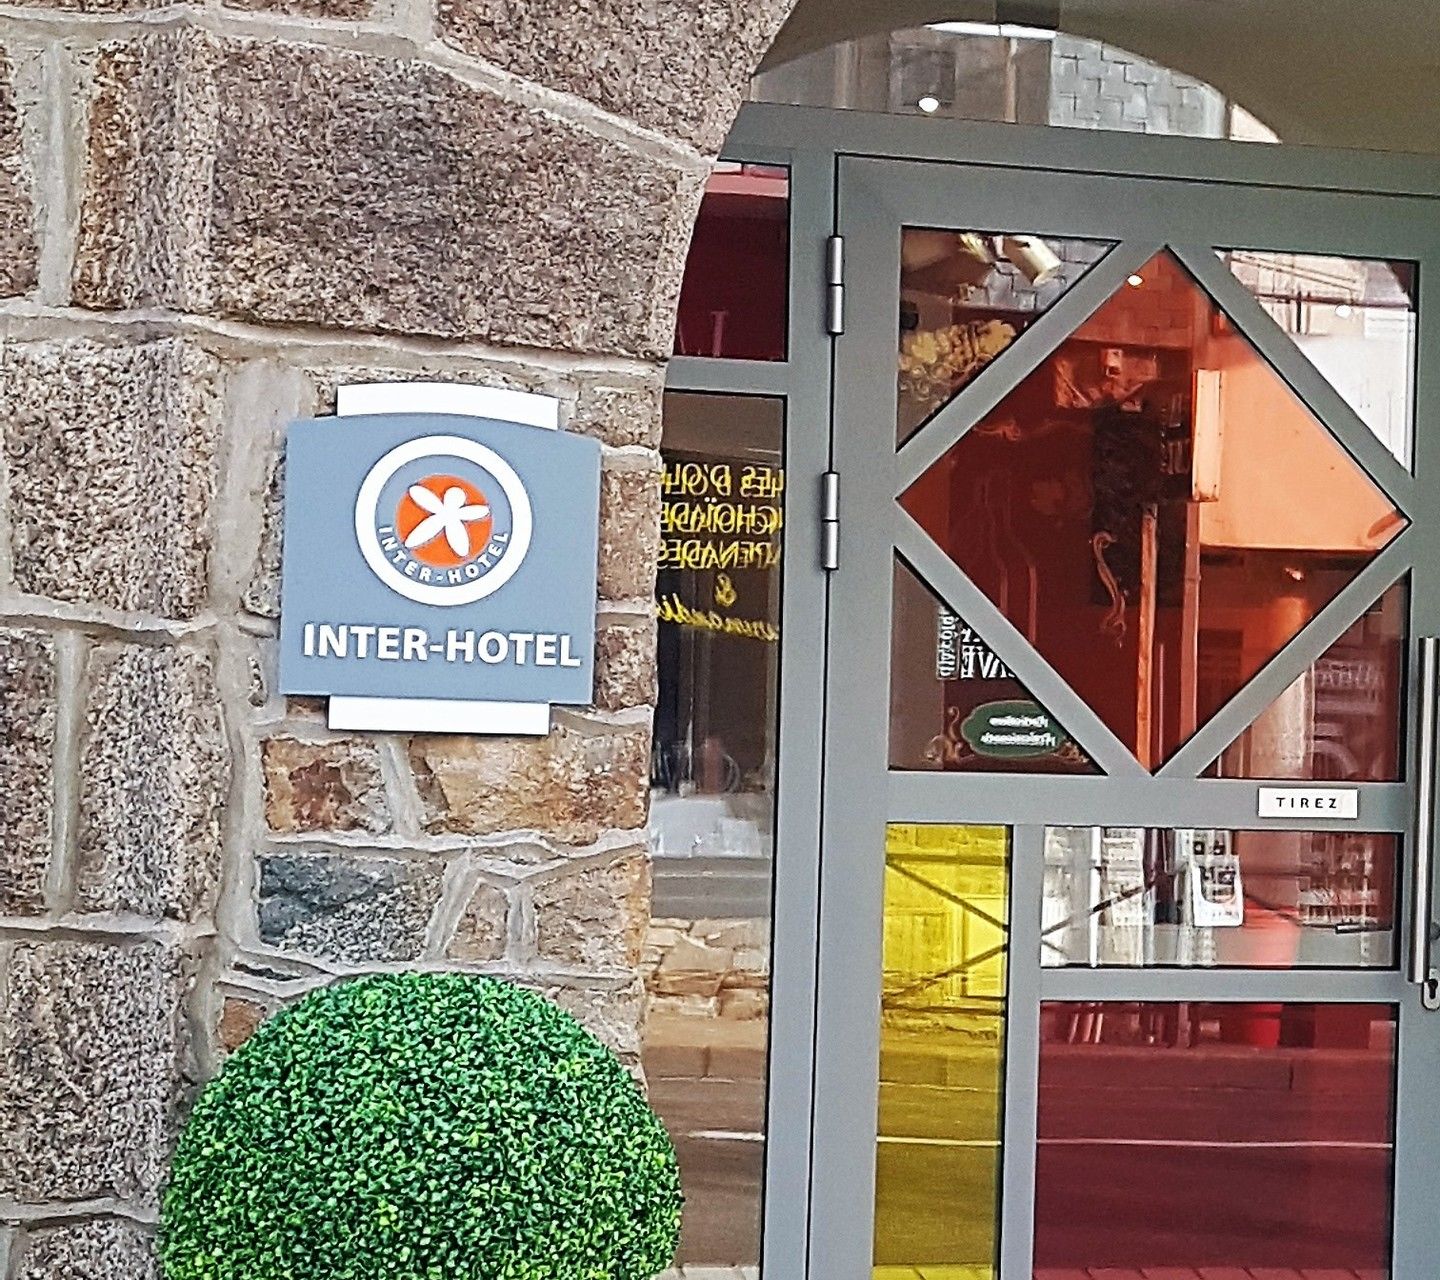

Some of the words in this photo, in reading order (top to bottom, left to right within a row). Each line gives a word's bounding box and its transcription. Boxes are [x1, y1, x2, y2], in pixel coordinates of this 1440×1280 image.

[378, 526, 510, 585] INTER-HOTEL
[303, 622, 581, 668] INTER-HOTEL
[1275, 797, 1337, 809] TIREZ
